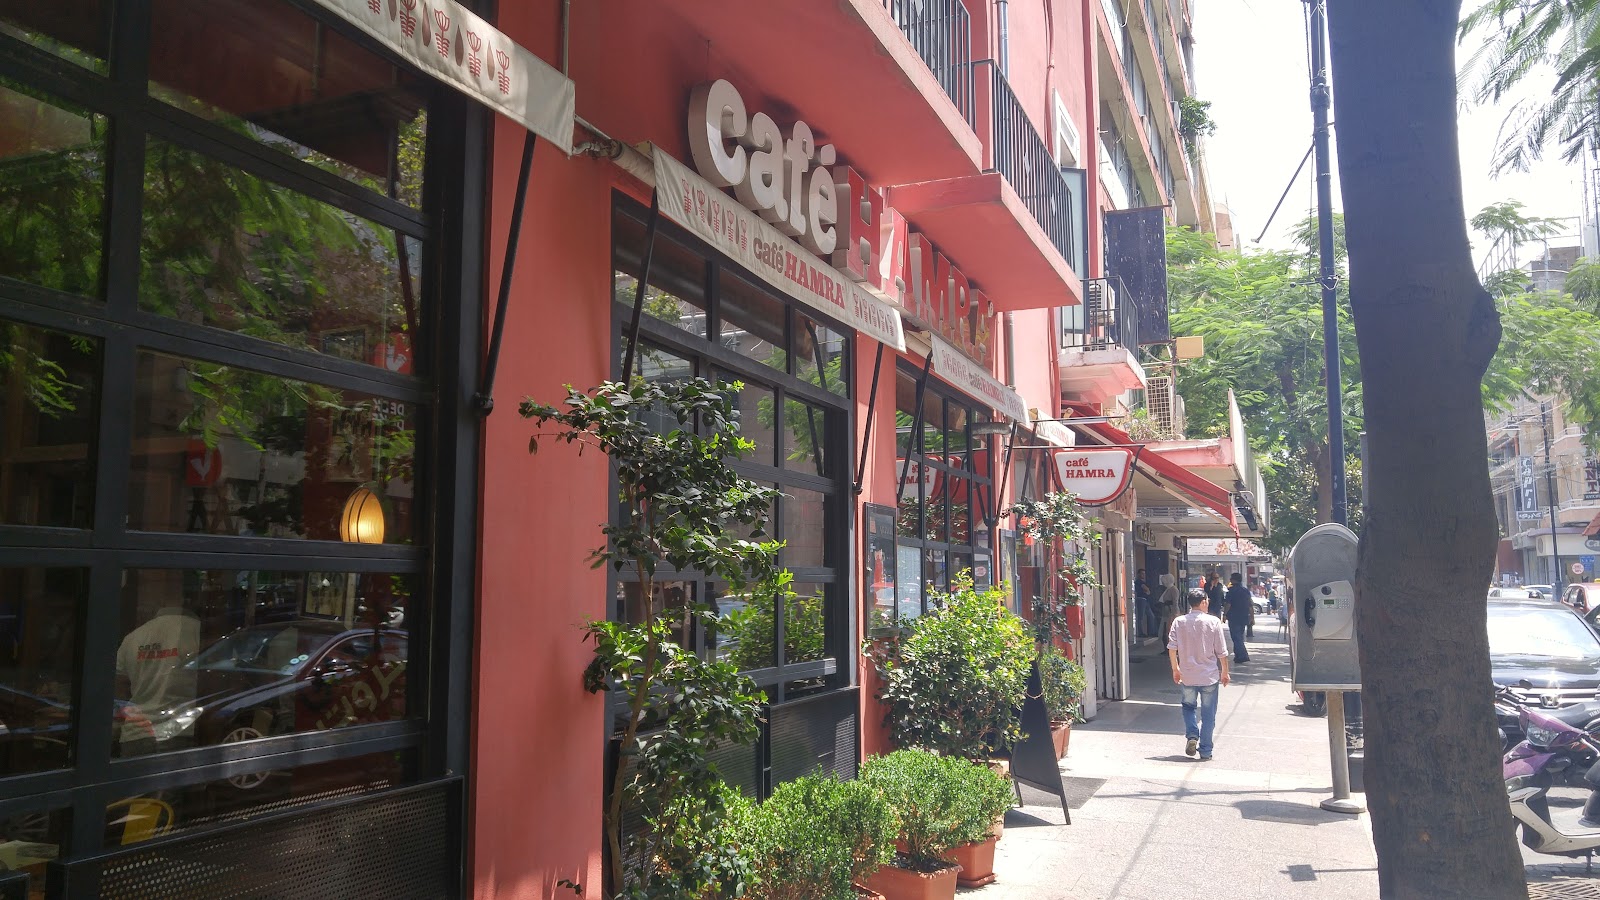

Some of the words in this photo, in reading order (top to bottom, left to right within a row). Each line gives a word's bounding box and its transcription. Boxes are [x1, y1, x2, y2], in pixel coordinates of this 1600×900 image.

[689, 78, 838, 255] café
[835, 165, 994, 373] HAMRA
[753, 237, 784, 274] café
[784, 251, 845, 309] HAMRA
[1065, 457, 1089, 467] café
[1065, 468, 1116, 479] HAMRA
